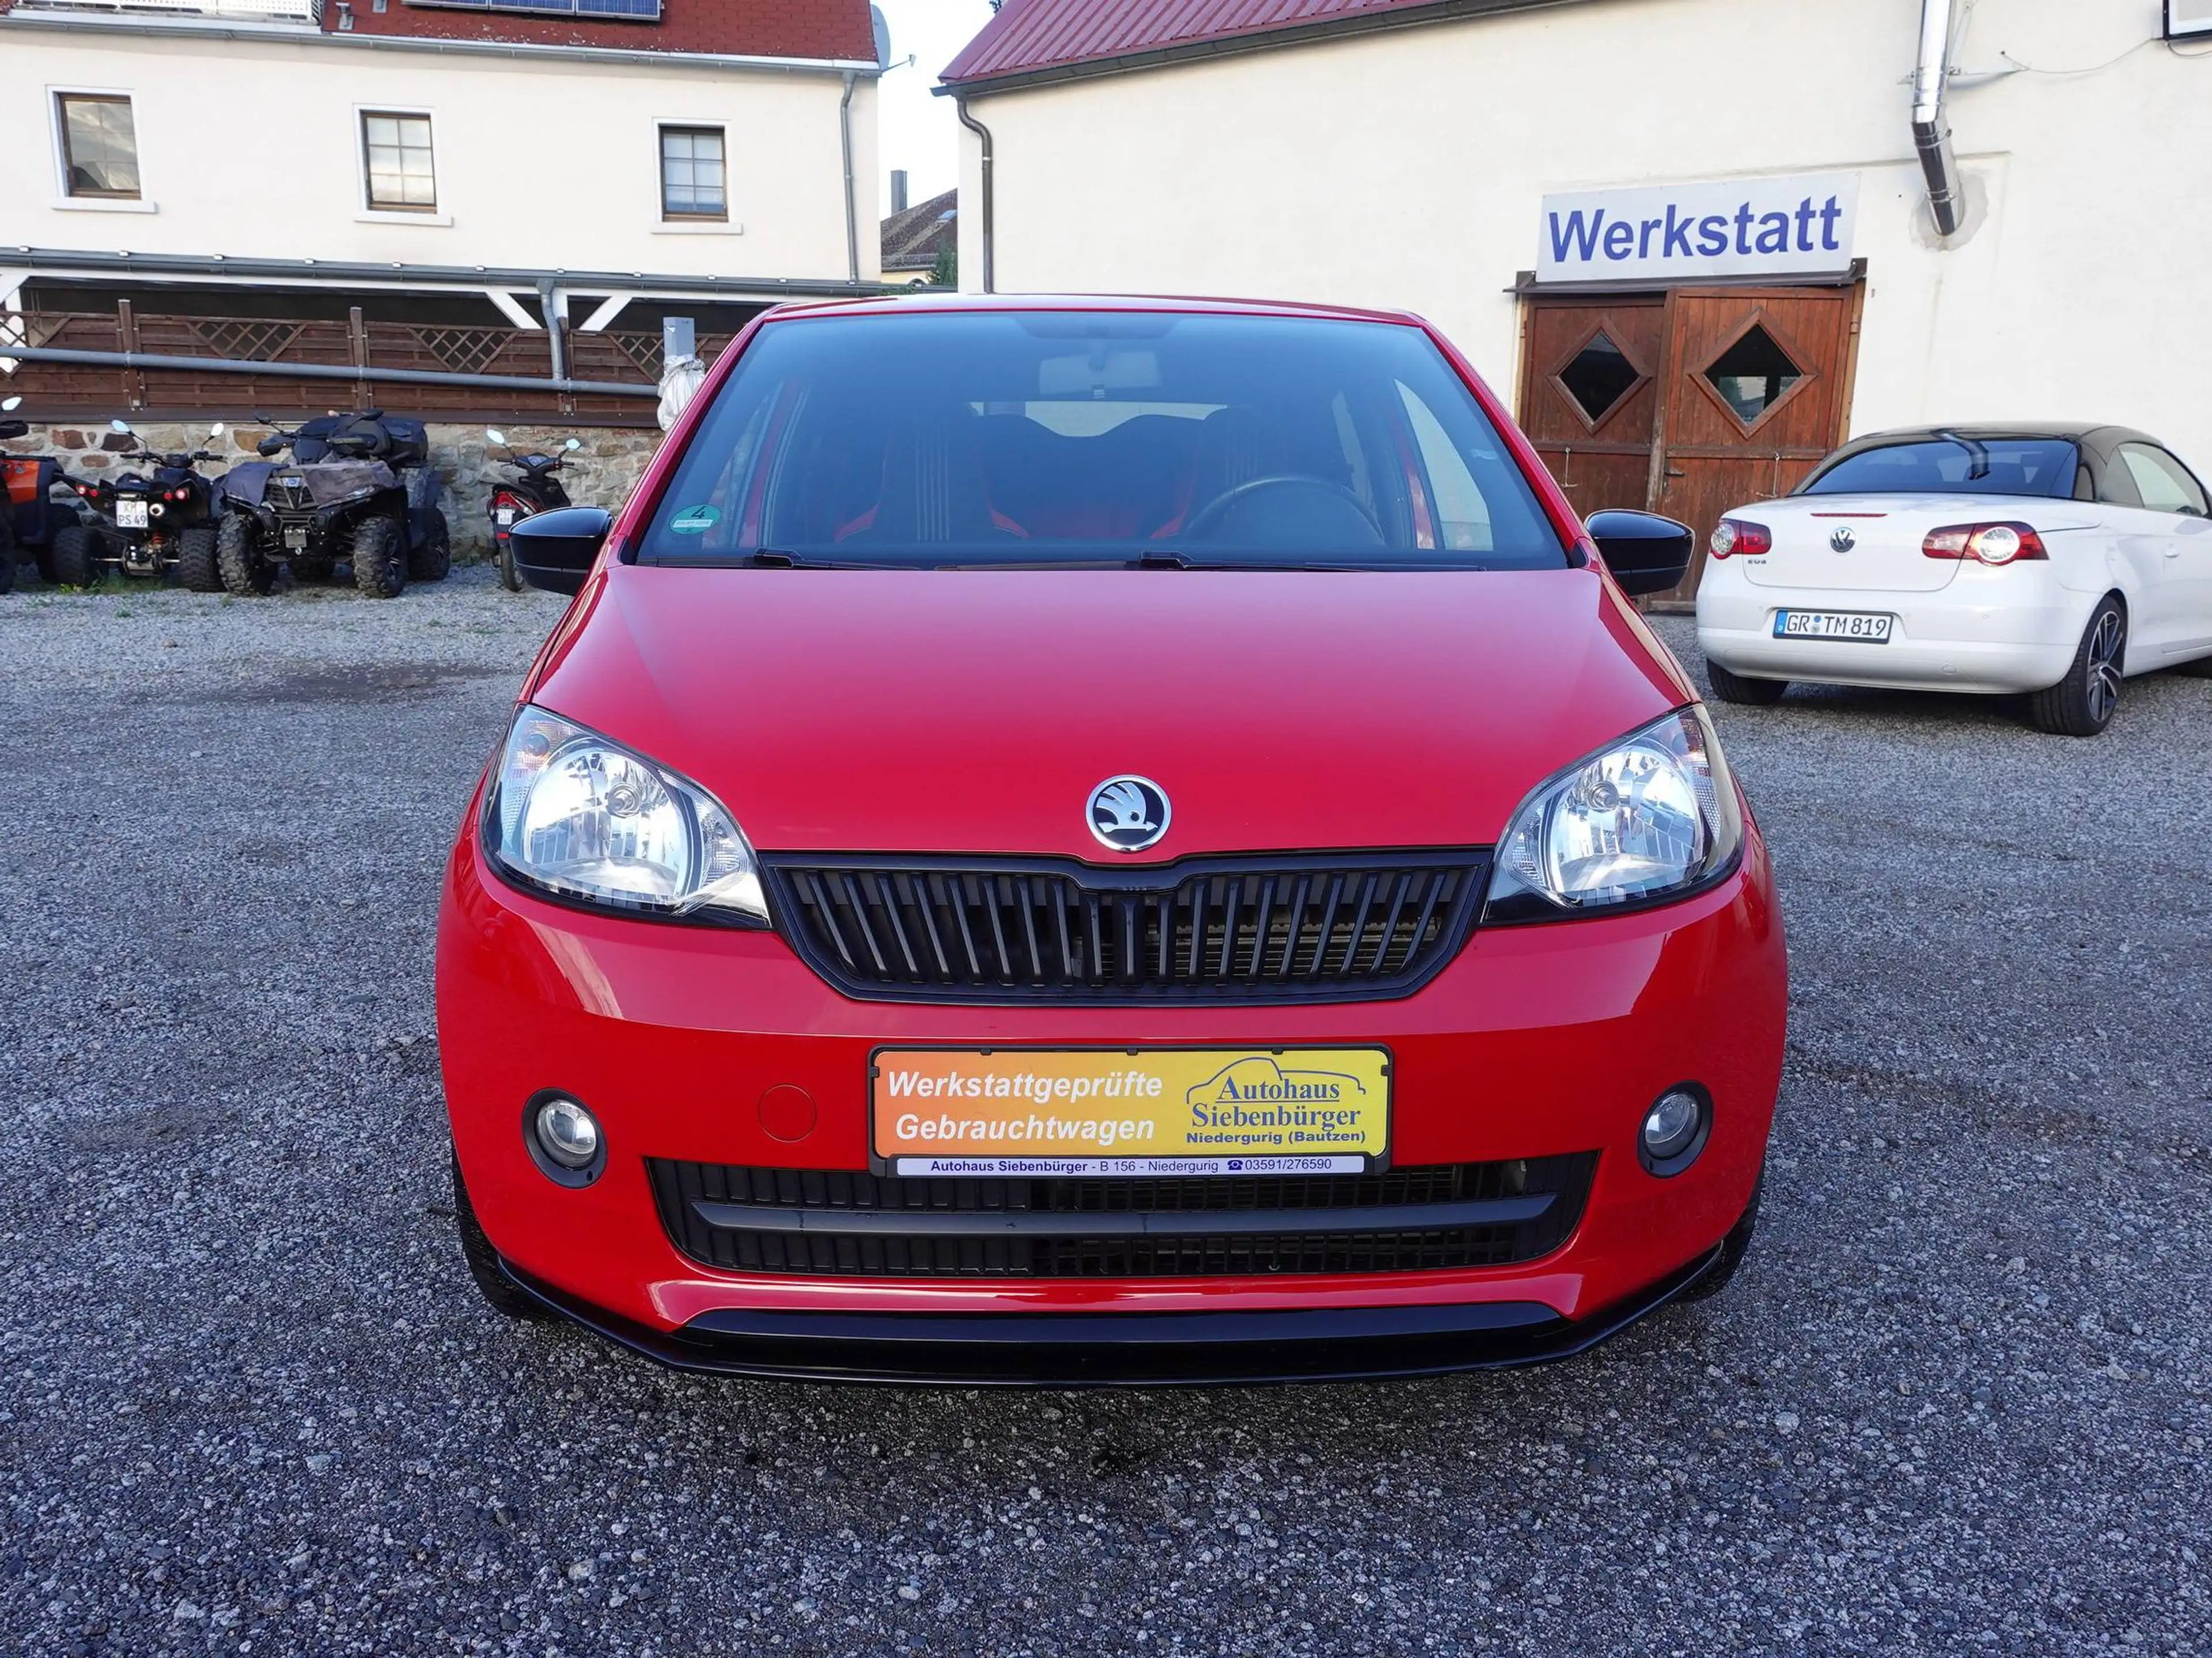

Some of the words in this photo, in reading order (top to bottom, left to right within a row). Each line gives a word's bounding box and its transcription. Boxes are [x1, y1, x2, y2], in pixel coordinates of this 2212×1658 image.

[1548, 194, 1842, 262] Werkstatt
[691, 506, 706, 519] 4
[1787, 614, 1810, 632] GR
[1824, 616, 1847, 633] TM
[1851, 617, 1887, 636] 819
[888, 1071, 1162, 1103] Werkstattgeprüfte
[1217, 1075, 1340, 1100] Autohaus
[1192, 1102, 1361, 1132] Siebenbürger
[896, 1114, 1155, 1146] Gebrauchtwagen
[1186, 1132, 1283, 1145] Niedergurig
[1288, 1130, 1366, 1144] (Bautzen)
[931, 1160, 994, 1172] Autohaus
[998, 1160, 1088, 1174] Siebenbürger
[1100, 1161, 1109, 1171] B
[1113, 1161, 1136, 1171] 156
[1148, 1160, 1219, 1173] Niedergurig
[1245, 1159, 1332, 1170] 03591/276590
